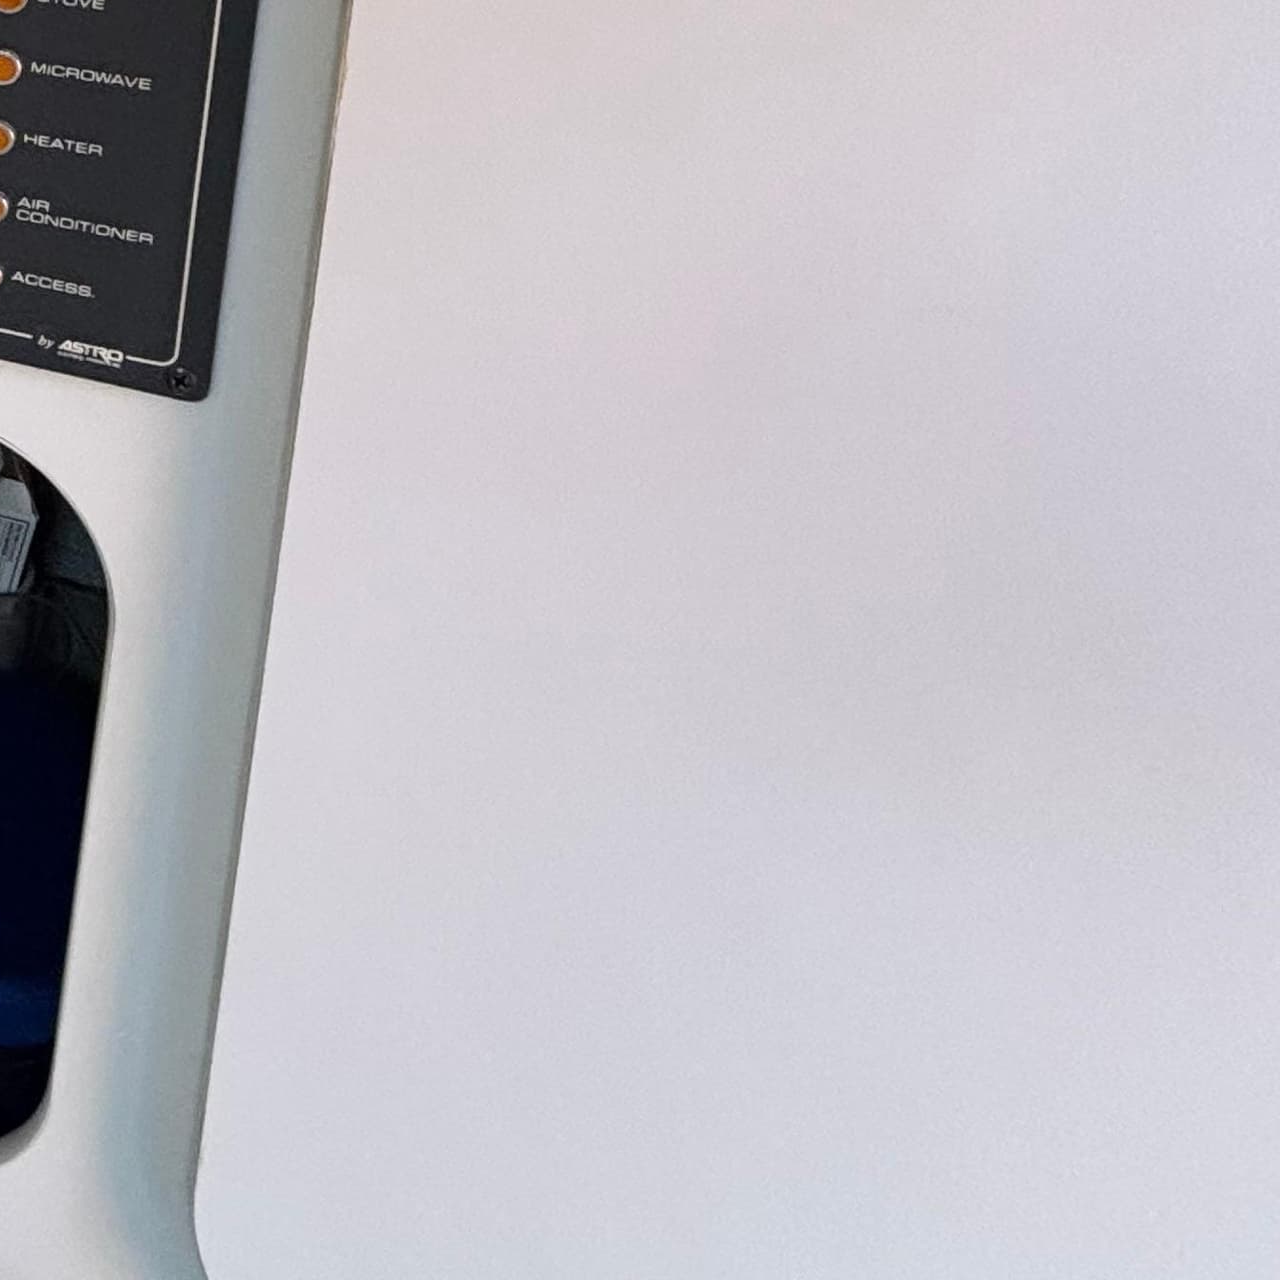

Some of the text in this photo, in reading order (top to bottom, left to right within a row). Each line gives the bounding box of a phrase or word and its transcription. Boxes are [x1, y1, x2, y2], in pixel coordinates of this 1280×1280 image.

[31, 62, 151, 90] MICROWAVE
[24, 134, 102, 156] HEATER
[17, 197, 50, 212] AIR
[16, 210, 154, 245] CONDITIONER
[11, 272, 95, 298] ACCESS.
[38, 335, 54, 349] by
[58, 340, 123, 366] ASTRO
